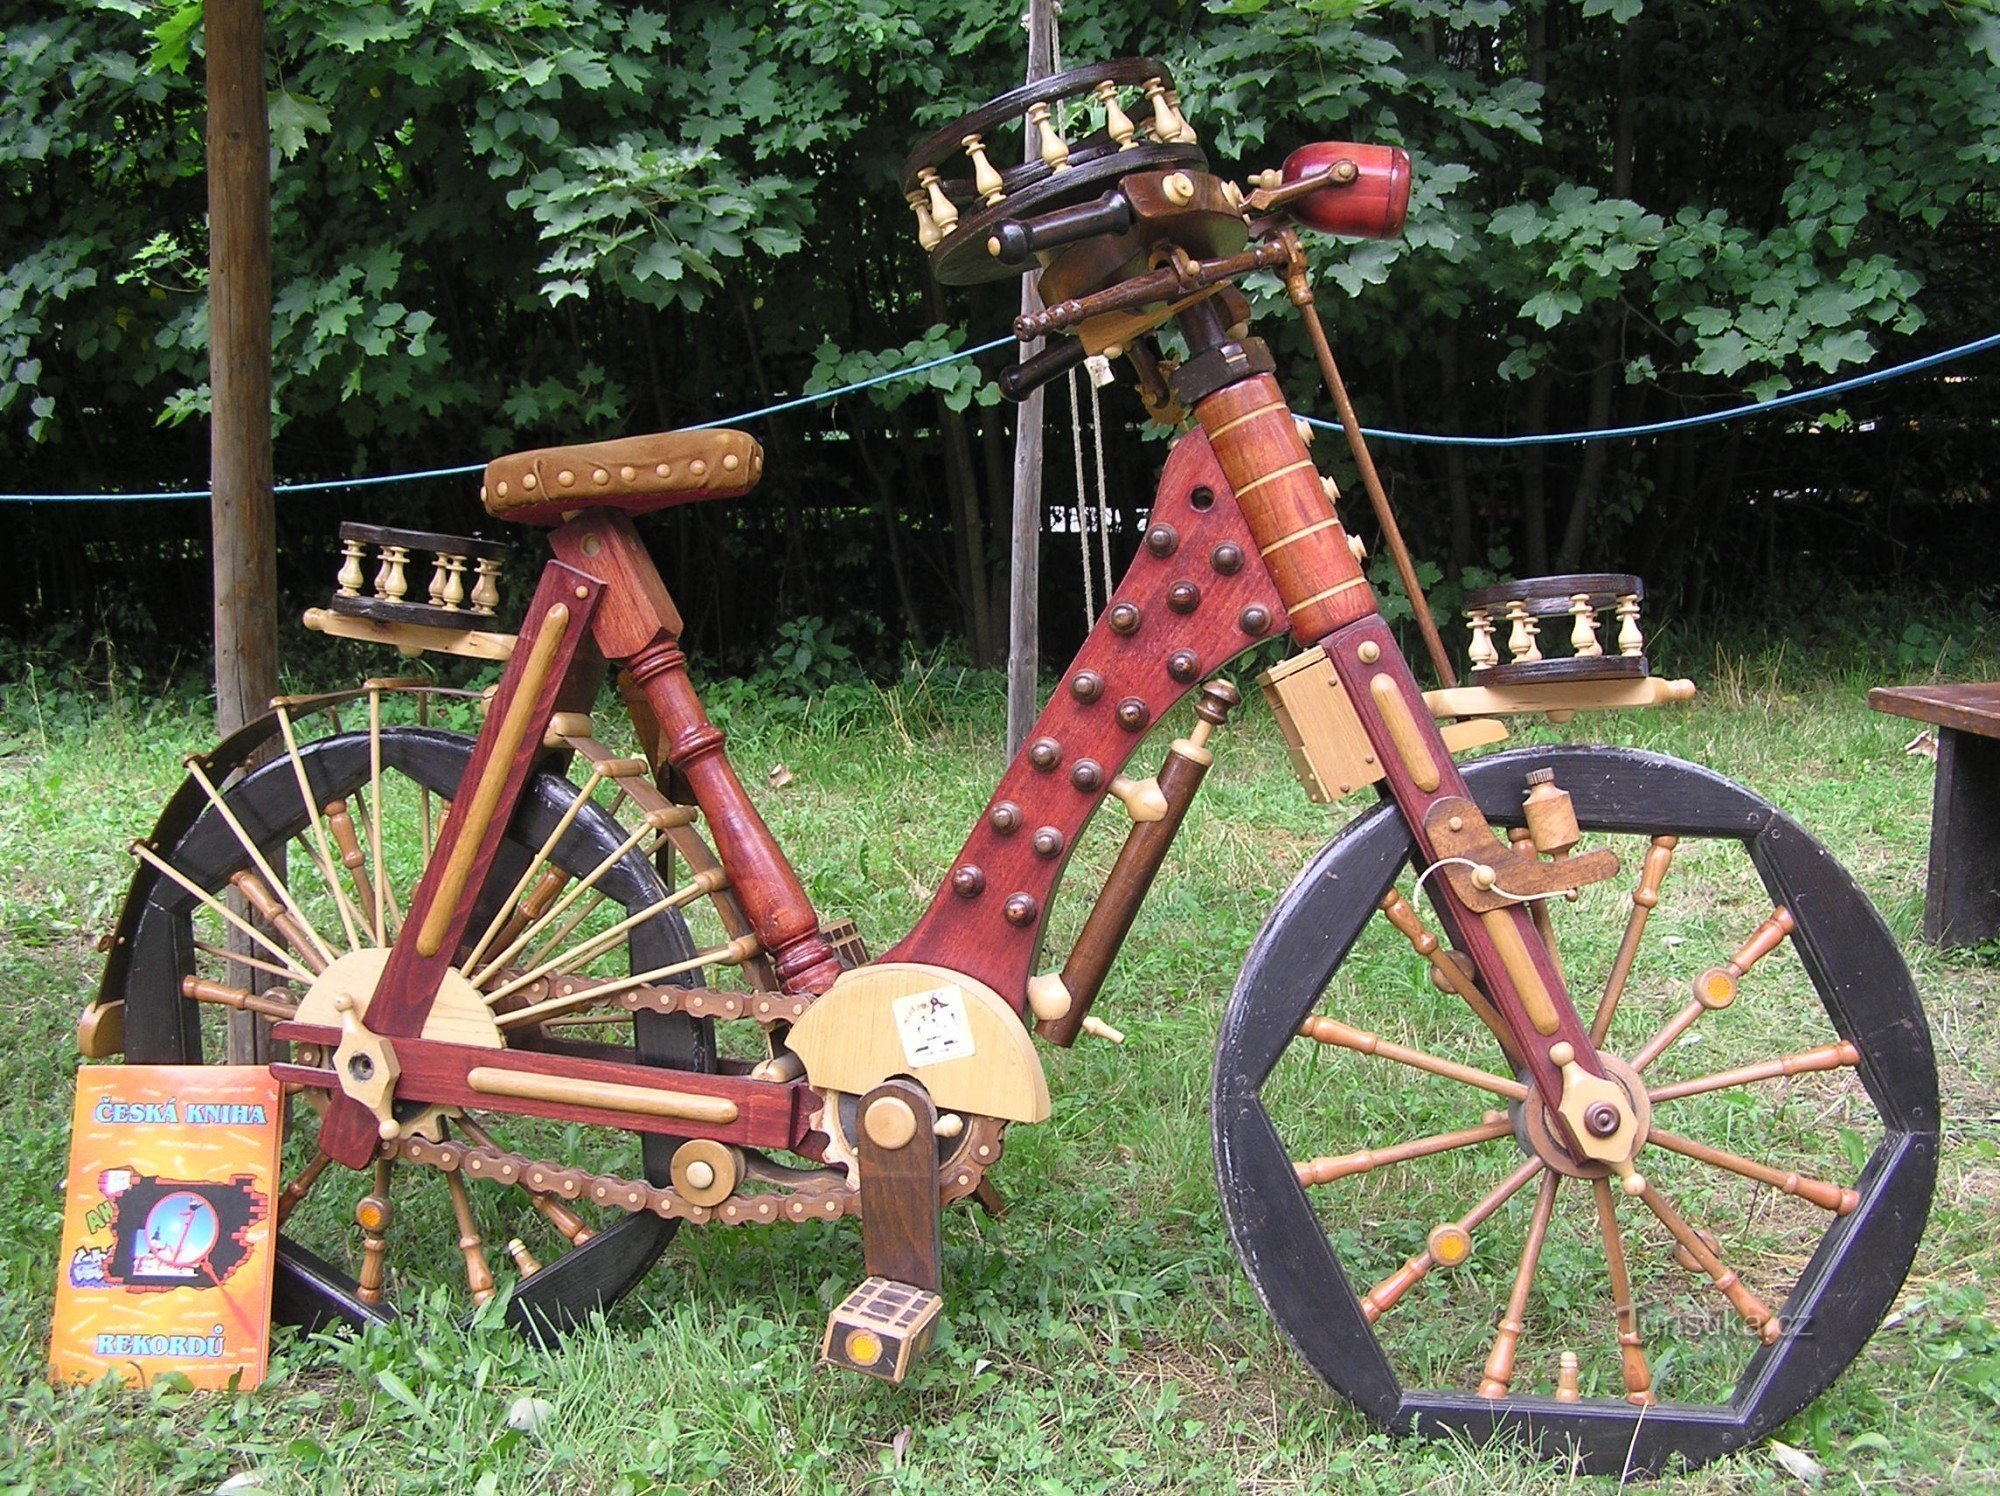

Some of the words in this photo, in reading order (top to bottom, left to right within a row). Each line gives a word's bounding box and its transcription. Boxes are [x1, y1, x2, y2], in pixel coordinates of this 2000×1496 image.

[94, 1096, 179, 1123] ČESKÁ
[185, 1103, 267, 1125] KNIHA
[97, 1324, 225, 1357] REKORDŮ
